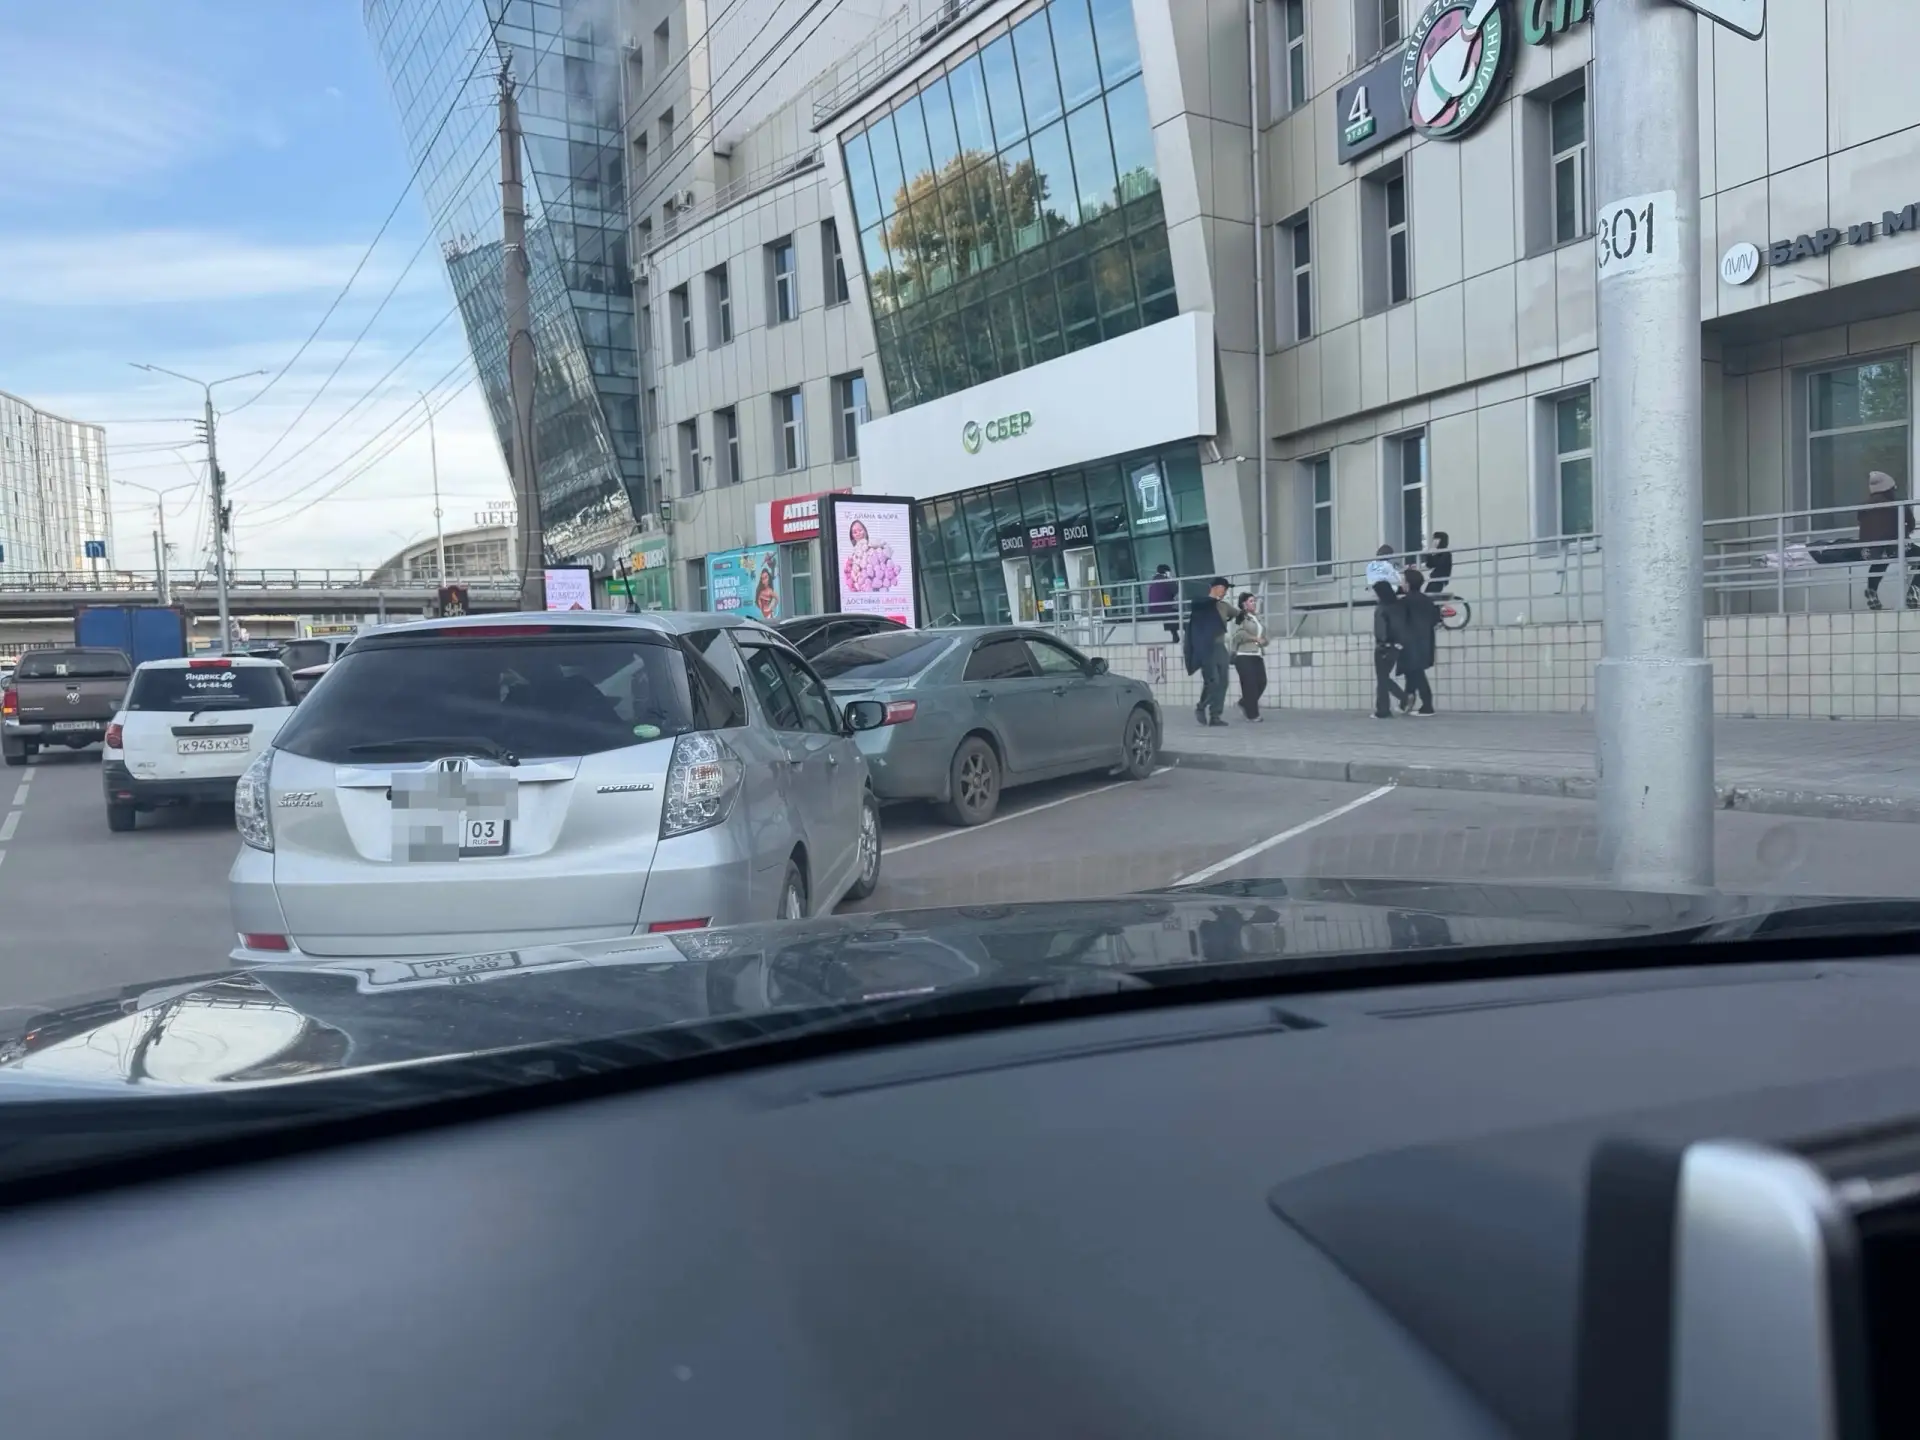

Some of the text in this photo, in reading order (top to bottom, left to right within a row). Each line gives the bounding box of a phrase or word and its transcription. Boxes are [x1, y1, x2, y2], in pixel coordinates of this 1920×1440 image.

[1458, 23, 1498, 117] БОУЛИНГ
[1348, 86, 1368, 122] 4
[1768, 228, 1839, 267] БАР
[1882, 201, 1920, 237] М
[985, 411, 1031, 442] СБЕР
[1029, 525, 1056, 539] EURO
[1063, 525, 1089, 541] ВХОД
[1001, 536, 1024, 551] ВХОД
[185, 672, 221, 681] Яндекс
[472, 821, 495, 838] 03
